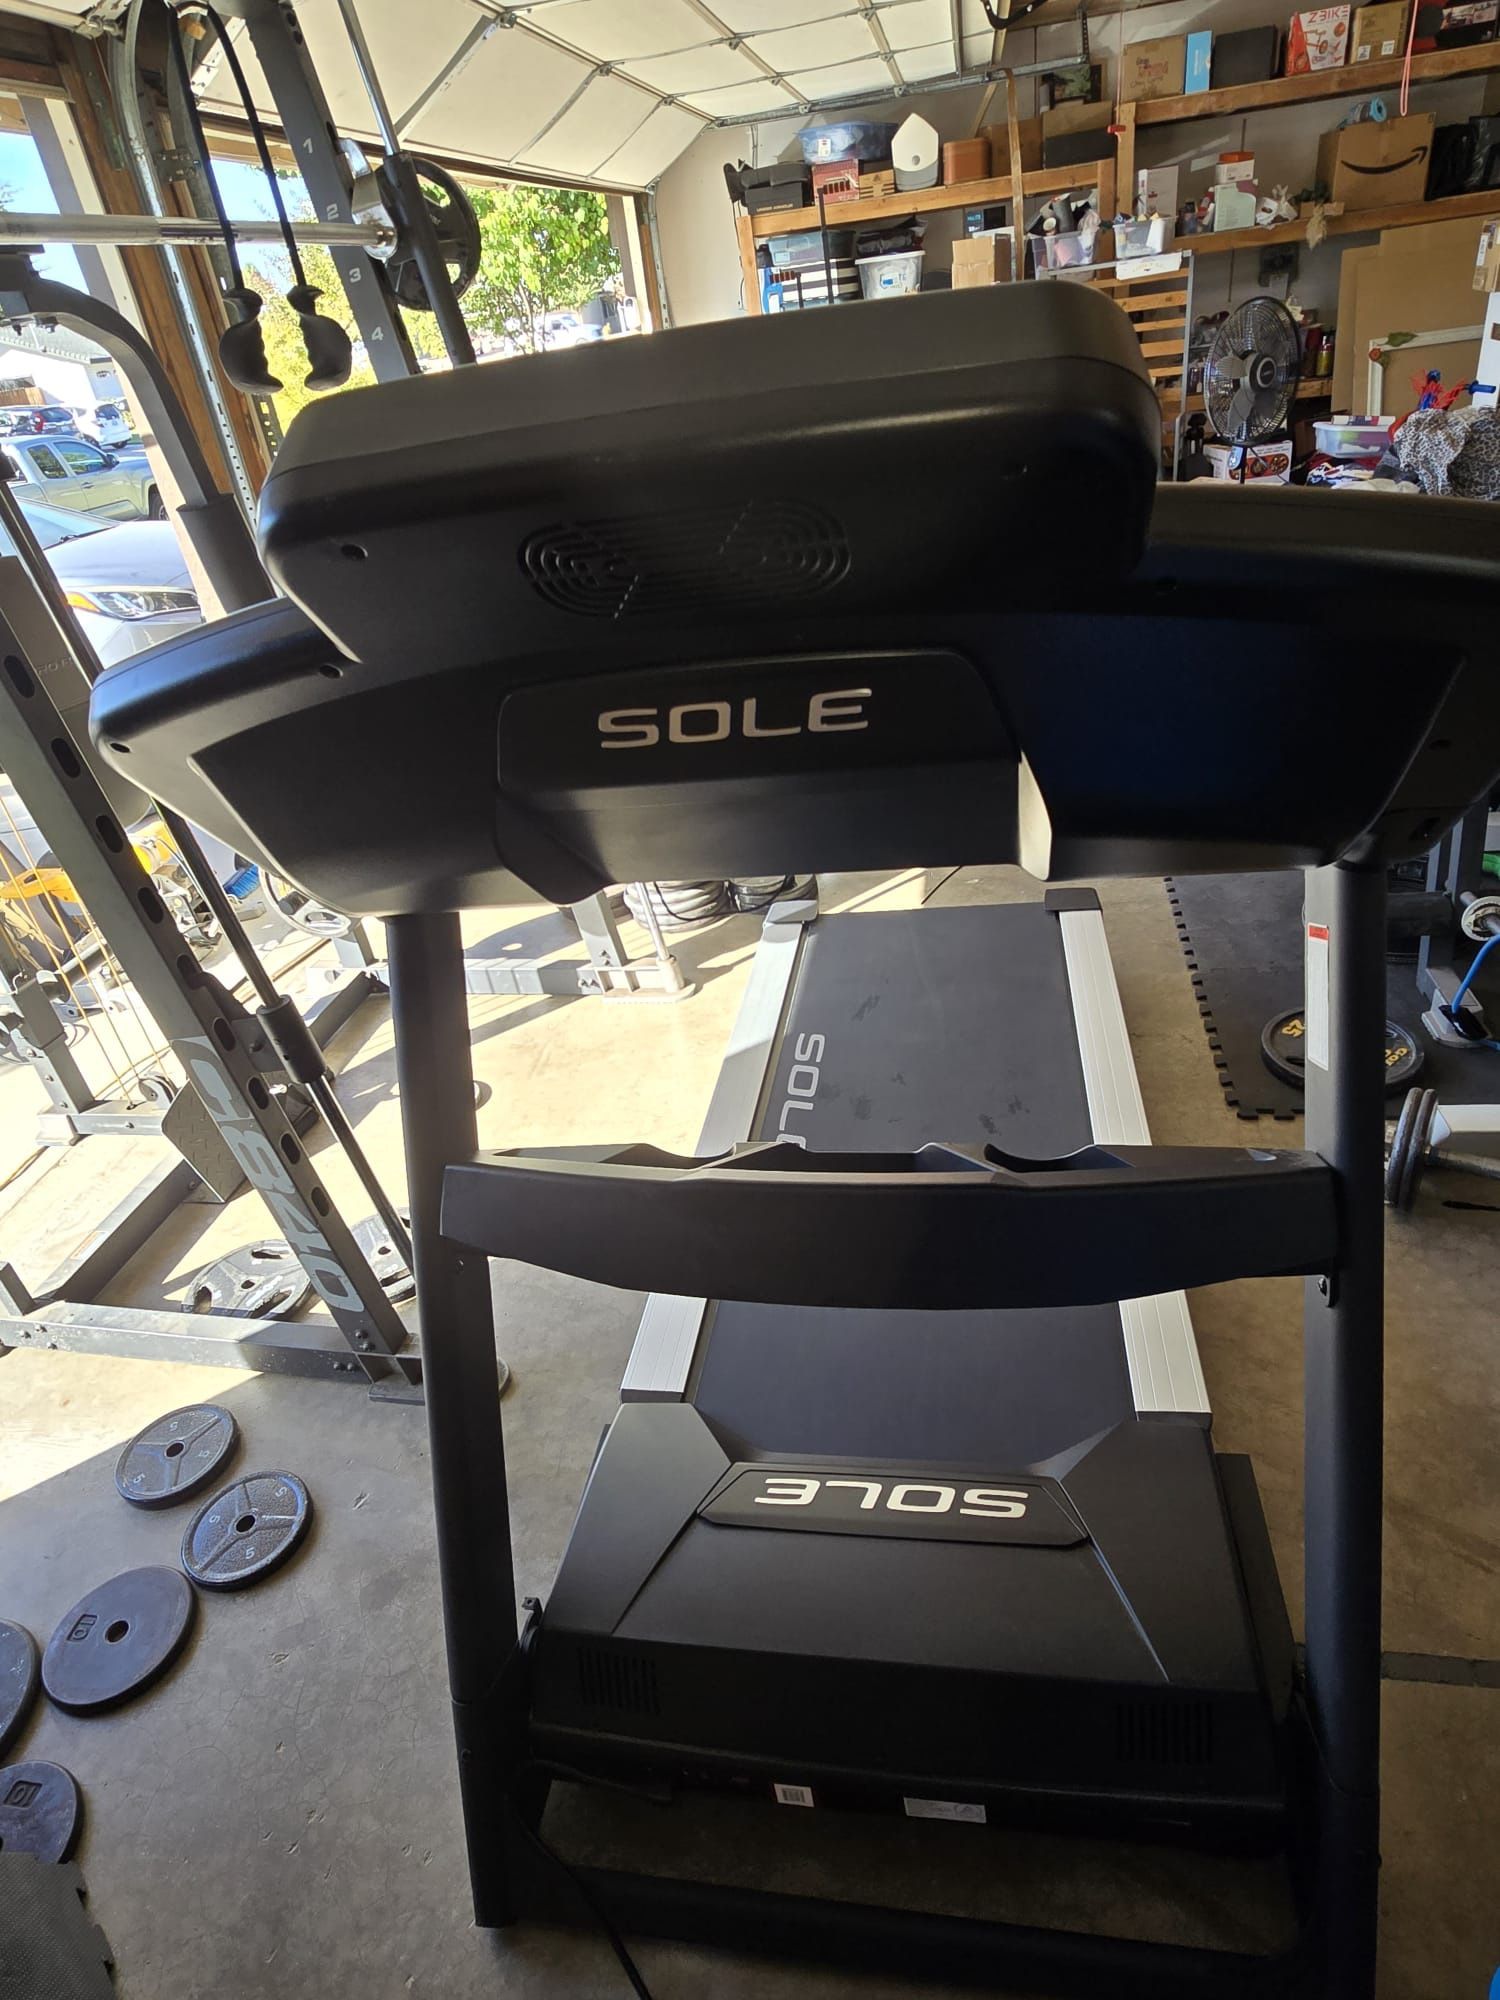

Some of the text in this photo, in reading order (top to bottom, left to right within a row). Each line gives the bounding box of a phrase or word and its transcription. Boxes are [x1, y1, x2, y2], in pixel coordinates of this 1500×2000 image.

[303, 137, 313, 154] 1
[326, 203, 339, 221] 2
[349, 267, 362, 283] 3
[371, 326, 384, 341] 4
[598, 688, 872, 749] SOLE
[754, 1478, 1029, 1519] SOLE
[245, 1547, 255, 1560] 5
